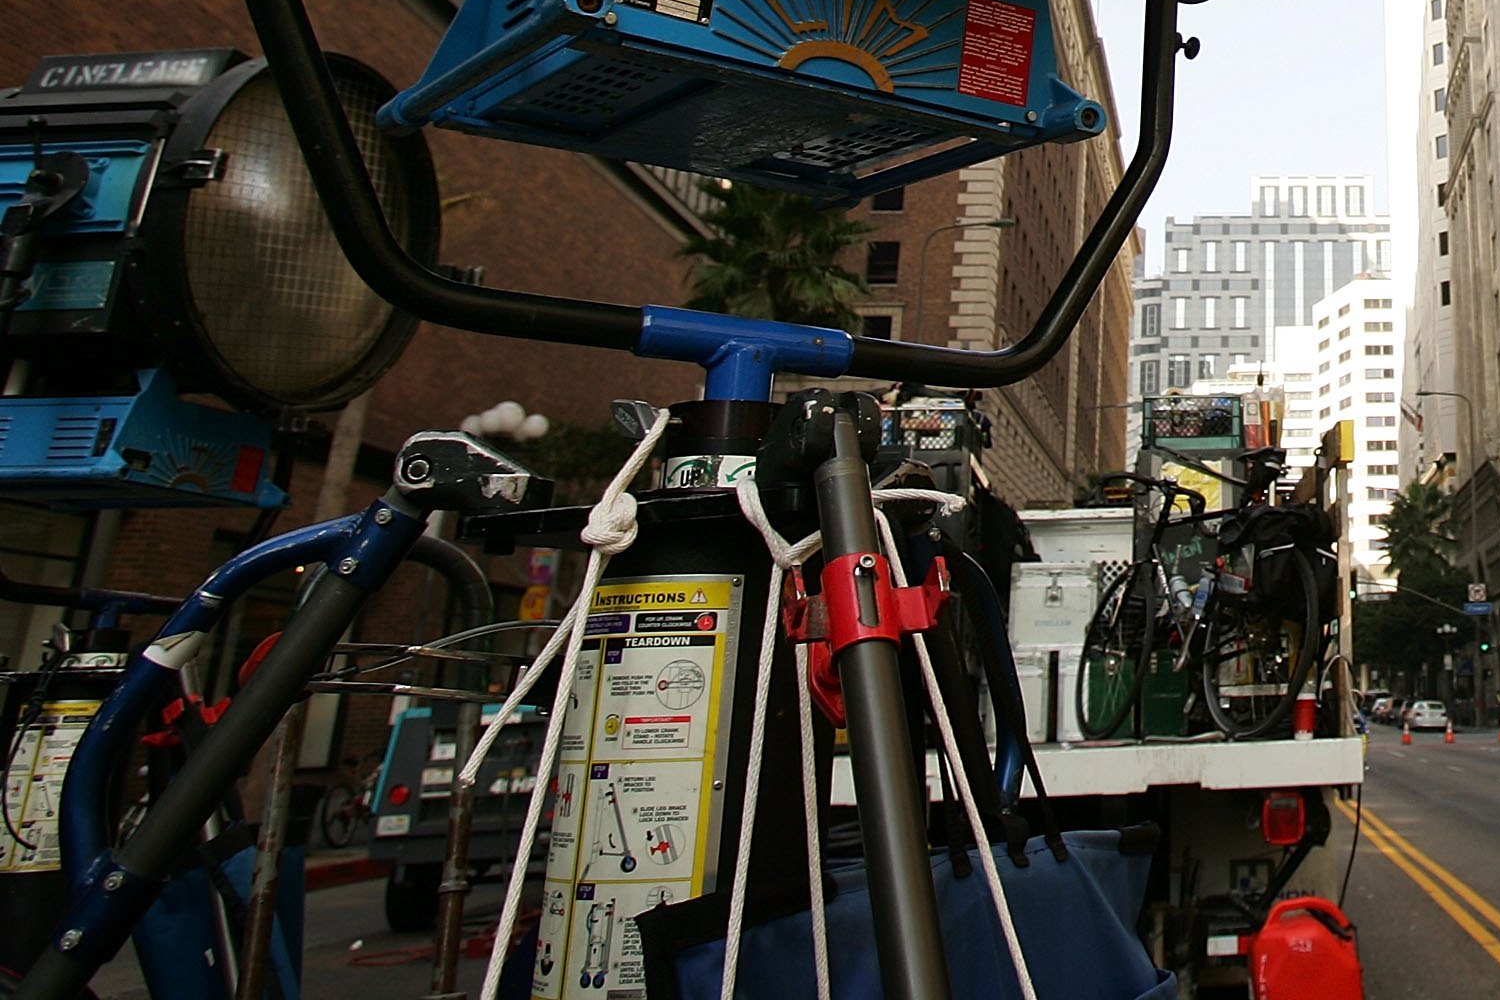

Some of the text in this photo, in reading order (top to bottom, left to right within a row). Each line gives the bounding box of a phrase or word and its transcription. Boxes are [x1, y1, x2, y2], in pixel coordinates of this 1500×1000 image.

[40, 58, 207, 87] CINELEASE
[595, 591, 685, 607] INSTRUCTIONS
[625, 636, 690, 647] TEARDOWN
